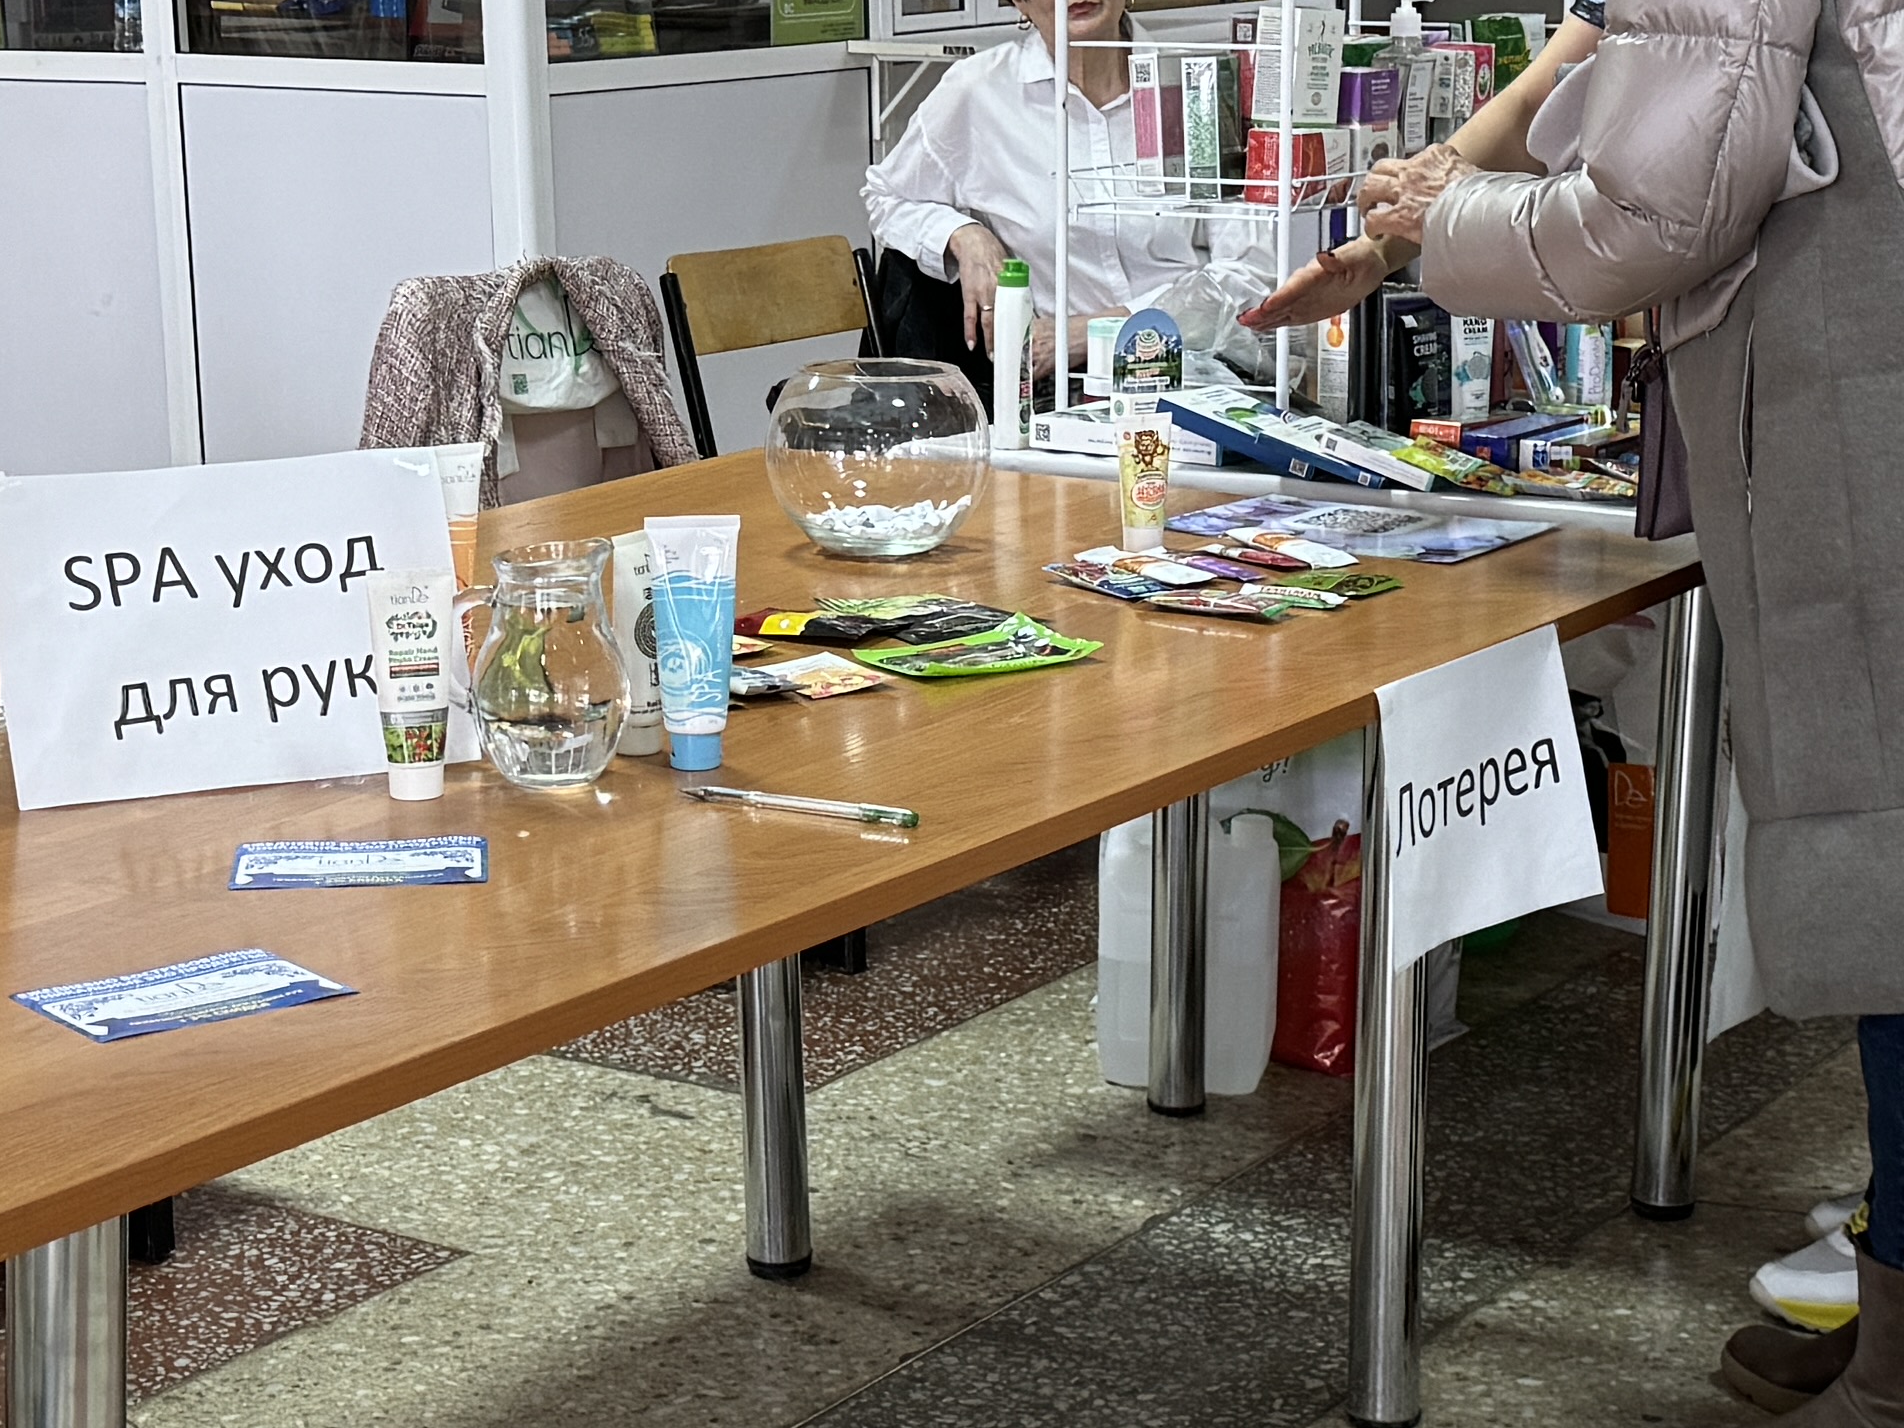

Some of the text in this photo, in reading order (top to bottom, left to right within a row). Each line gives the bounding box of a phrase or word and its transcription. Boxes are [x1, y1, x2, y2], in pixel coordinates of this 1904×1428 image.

[63, 535, 386, 611] SPA уход
[114, 654, 378, 741] для рук
[691, 668, 722, 702] SPA
[1396, 737, 1561, 859] Лотерея
